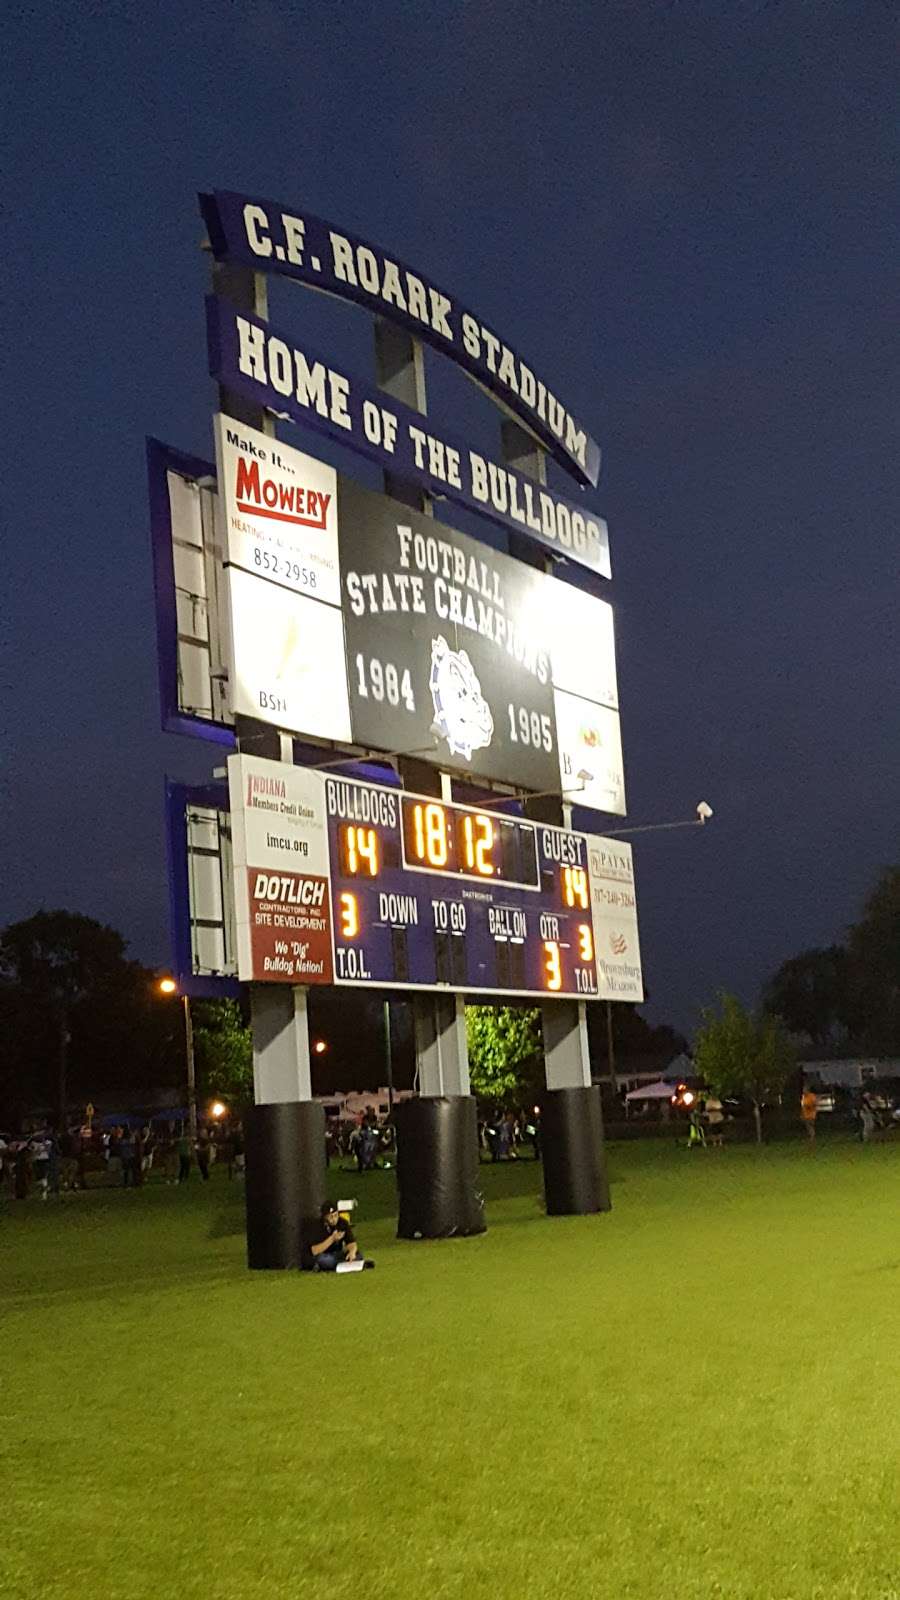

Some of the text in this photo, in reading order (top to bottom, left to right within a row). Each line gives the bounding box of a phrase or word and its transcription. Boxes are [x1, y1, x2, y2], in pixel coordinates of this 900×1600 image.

[243, 204, 587, 466] C.F. ROARK STADIUM
[227, 430, 266, 461] Make
[236, 316, 603, 562] HOME OF THE BULLDOGS
[254, 547, 316, 588] 852-2958
[396, 525, 505, 610] FOOTBALL
[346, 571, 426, 616] STATE
[356, 653, 416, 712] 1984
[508, 703, 553, 753] 1985
[247, 774, 286, 807] INDIANA
[253, 796, 279, 812] Members
[280, 801, 297, 816] Credit
[327, 780, 397, 829] BULLDOGS
[267, 832, 308, 856] imcu.org
[347, 826, 377, 876] 14
[543, 830, 582, 865] GUEST
[254, 874, 325, 906] DOTLICH
[564, 867, 589, 909] 14
[255, 912, 326, 931] SITE DEVELOPMENT
[340, 892, 357, 937] 3
[379, 893, 418, 925] DOWN
[432, 900, 466, 931] TO GO
[489, 908, 527, 938] BALL ON
[540, 915, 560, 940] QTR
[578, 924, 593, 961] 3
[264, 957, 324, 976] Bulldog Nation!
[275, 940, 309, 959] We "Dig"
[337, 948, 371, 978] T.O.L.
[544, 941, 561, 990] 3
[575, 968, 598, 993] T.O.L.
